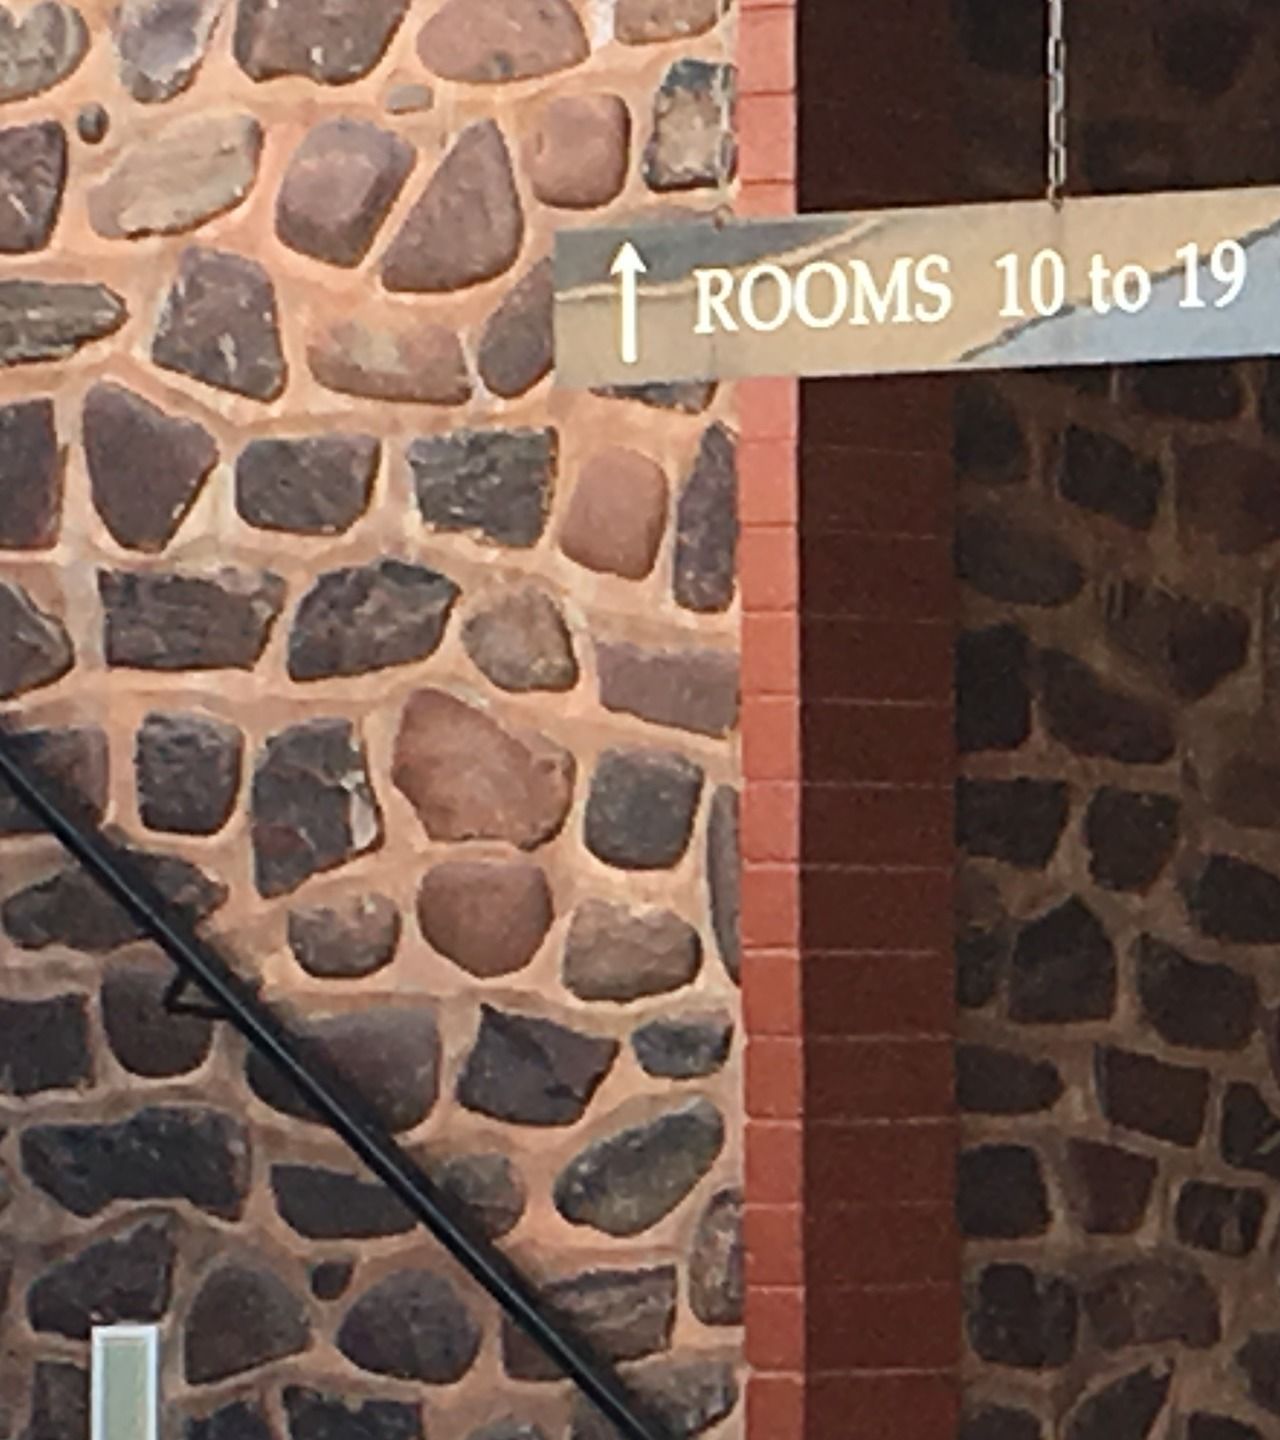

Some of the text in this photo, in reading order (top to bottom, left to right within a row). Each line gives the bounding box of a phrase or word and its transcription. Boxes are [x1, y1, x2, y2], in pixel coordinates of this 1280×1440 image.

[692, 253, 953, 334] ROOMS
[994, 247, 1066, 317] 10
[1087, 253, 1152, 315] to
[1174, 238, 1248, 309] 19
